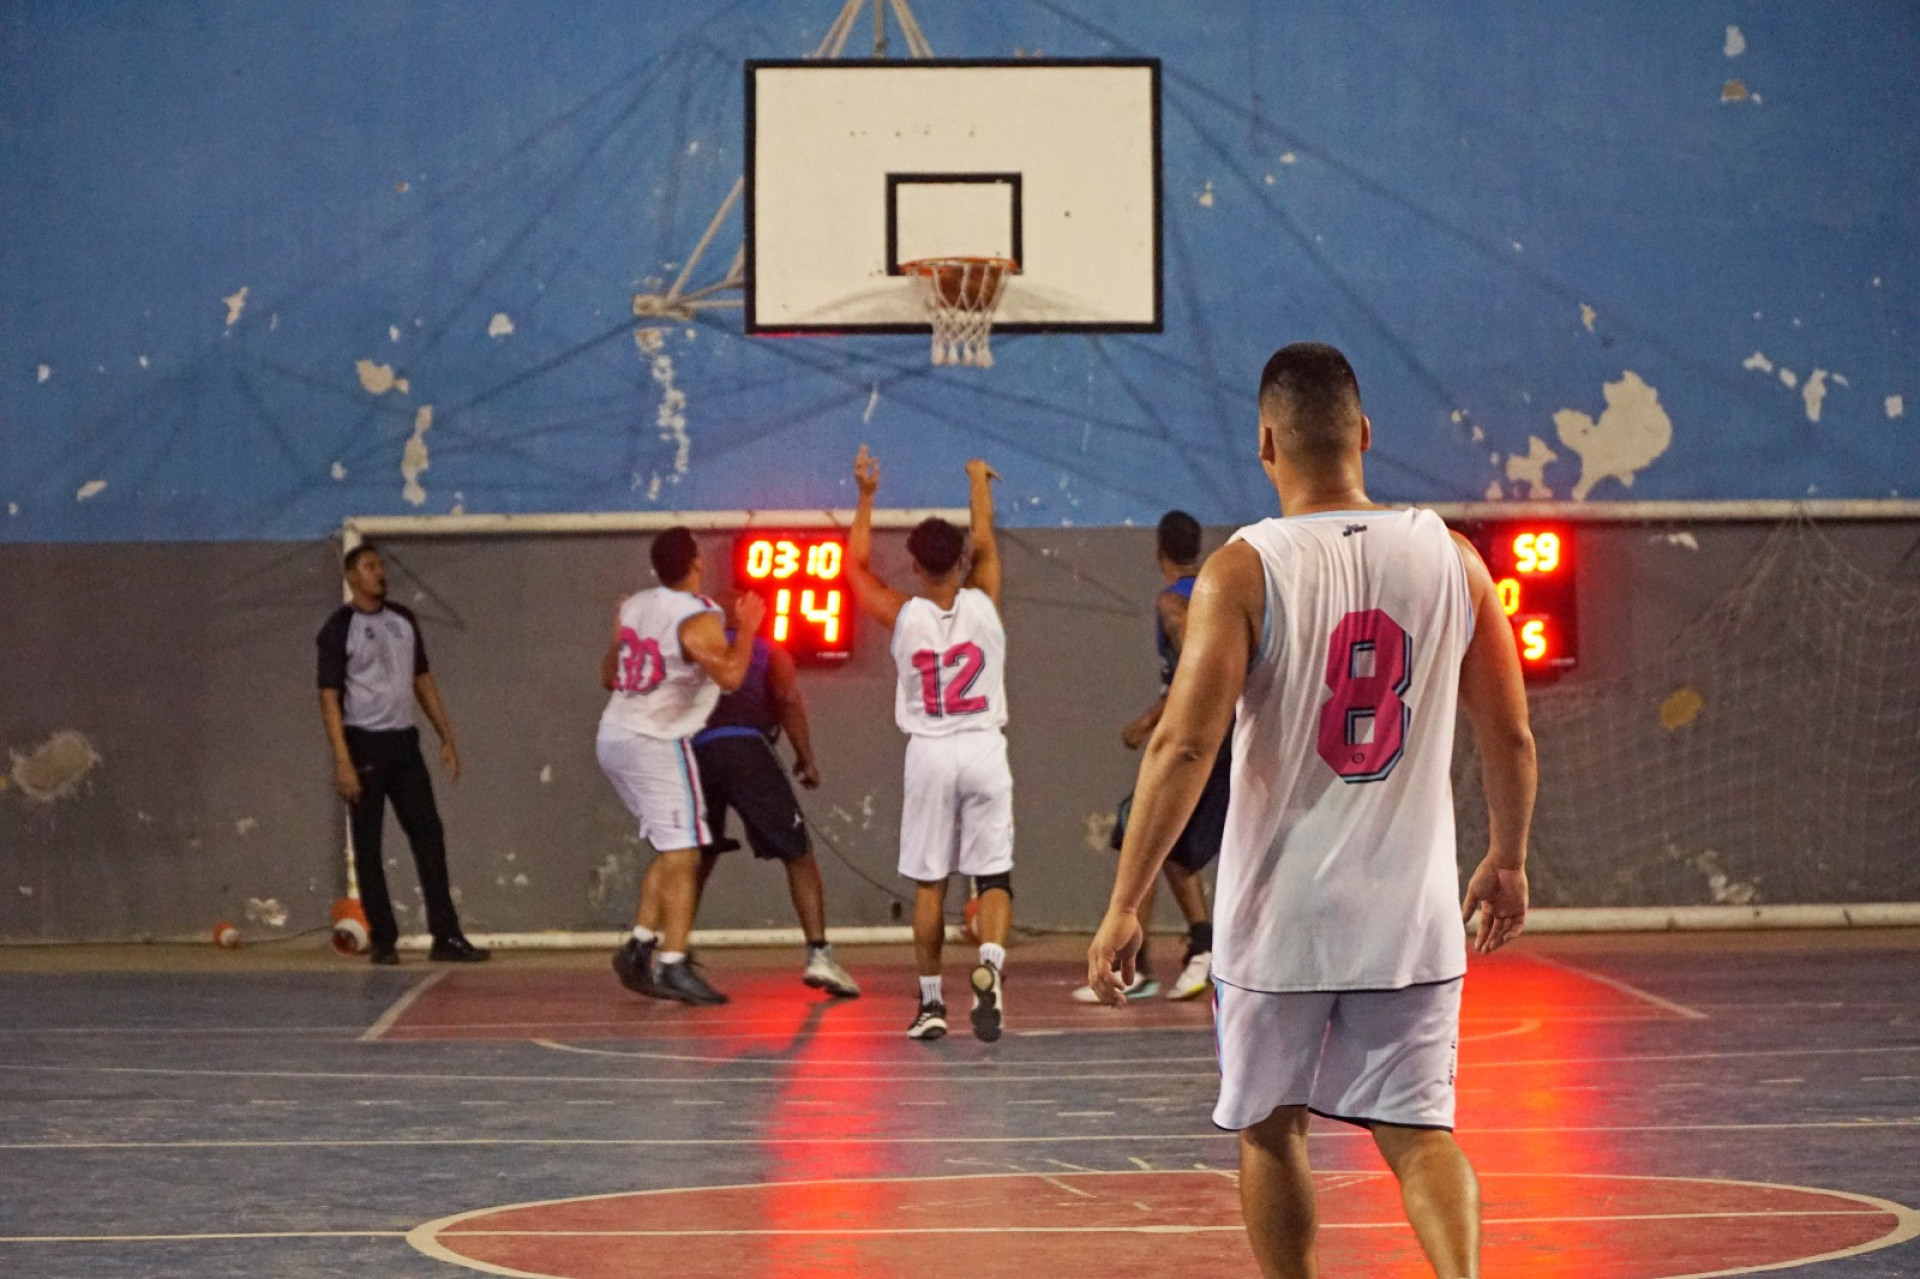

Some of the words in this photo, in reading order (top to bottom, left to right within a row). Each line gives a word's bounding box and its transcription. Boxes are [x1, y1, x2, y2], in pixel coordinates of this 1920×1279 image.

[1513, 532, 1560, 573] 59
[774, 589, 841, 642] 14
[912, 641, 988, 717] 12
[1316, 608, 1413, 784] 8
